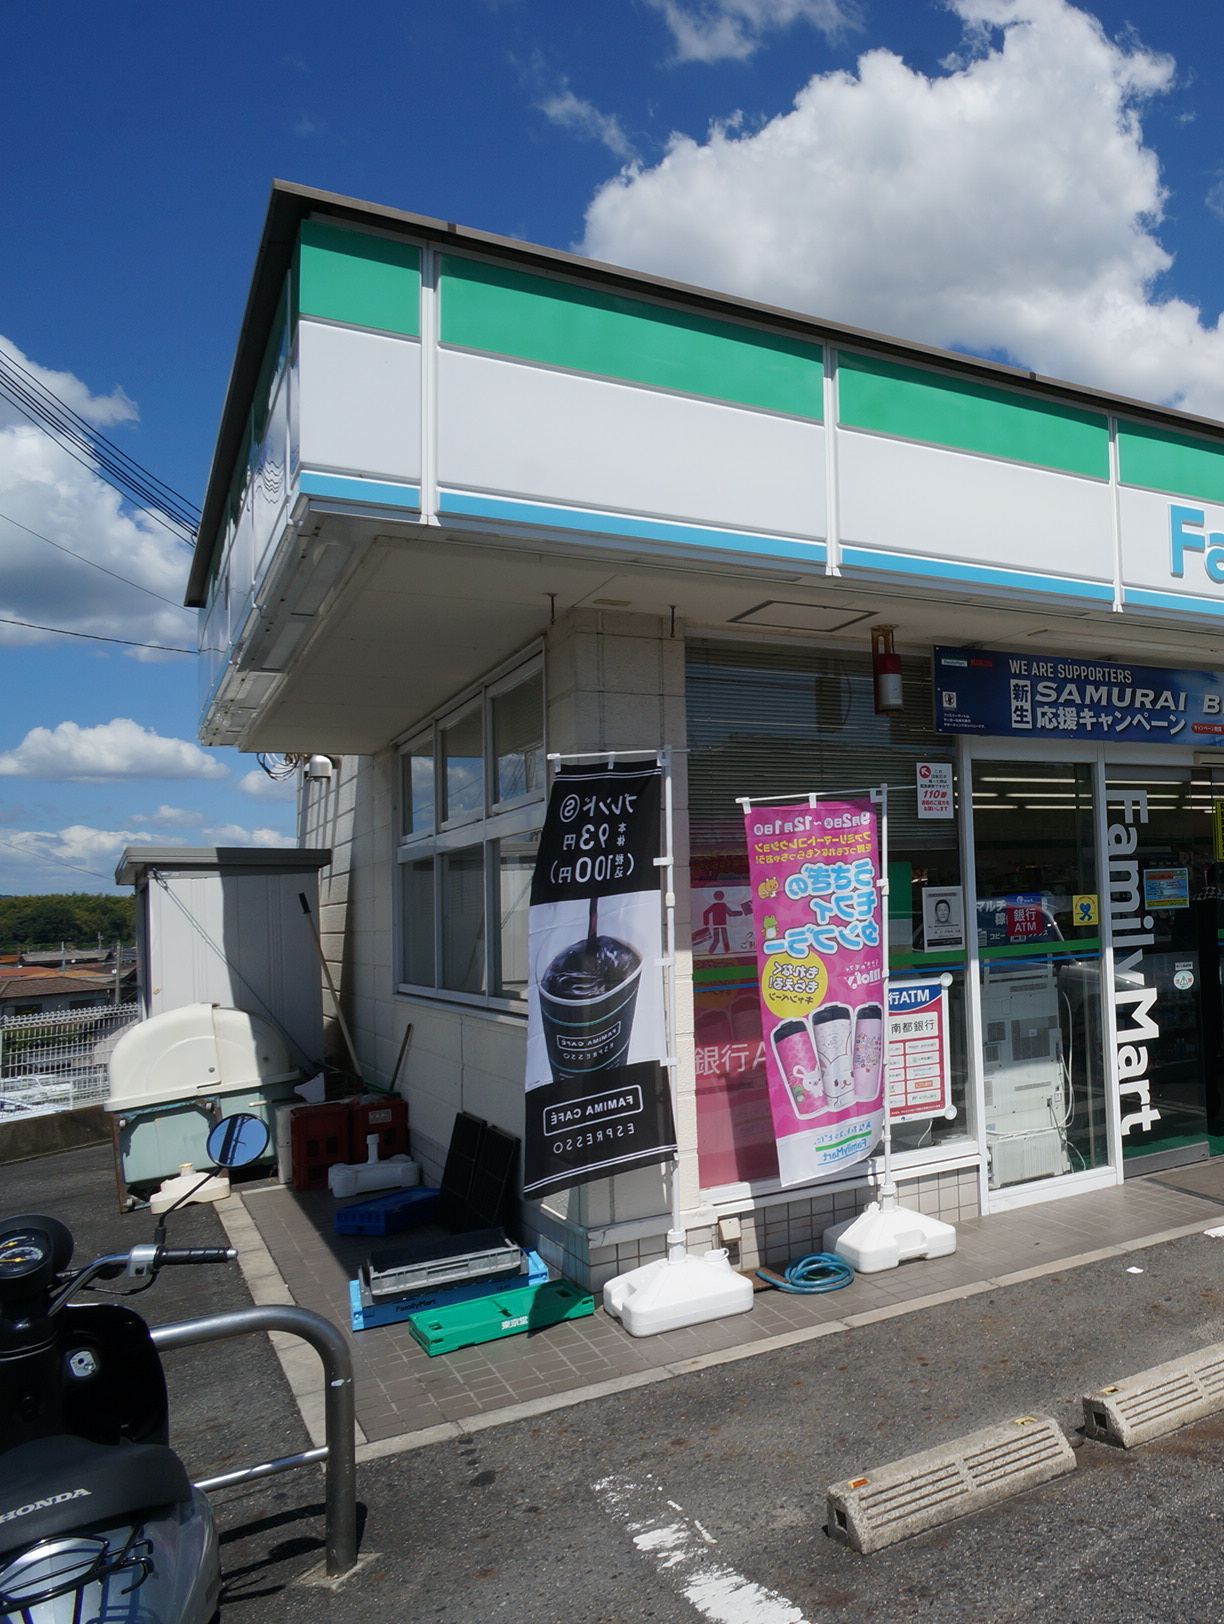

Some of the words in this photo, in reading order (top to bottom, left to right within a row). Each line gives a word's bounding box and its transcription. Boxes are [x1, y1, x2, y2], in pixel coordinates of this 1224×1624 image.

[1009, 659, 1028, 675] WE
[1031, 662, 1055, 678] ARE
[1057, 664, 1133, 684] SUPPORTERS
[1012, 682, 1031, 725] 新生
[1035, 681, 1188, 711] SAMURAI
[1036, 706, 1186, 735] 応援キャンペーン
[1014, 908, 1037, 922] 銀行
[1014, 921, 1037, 932] ATM
[1106, 790, 1161, 1136] FamilyMart
[891, 1019, 935, 1034] 南都銀行
[396, 1299, 437, 1312] FamilyMart
[0, 1488, 92, 1524] HONDA
